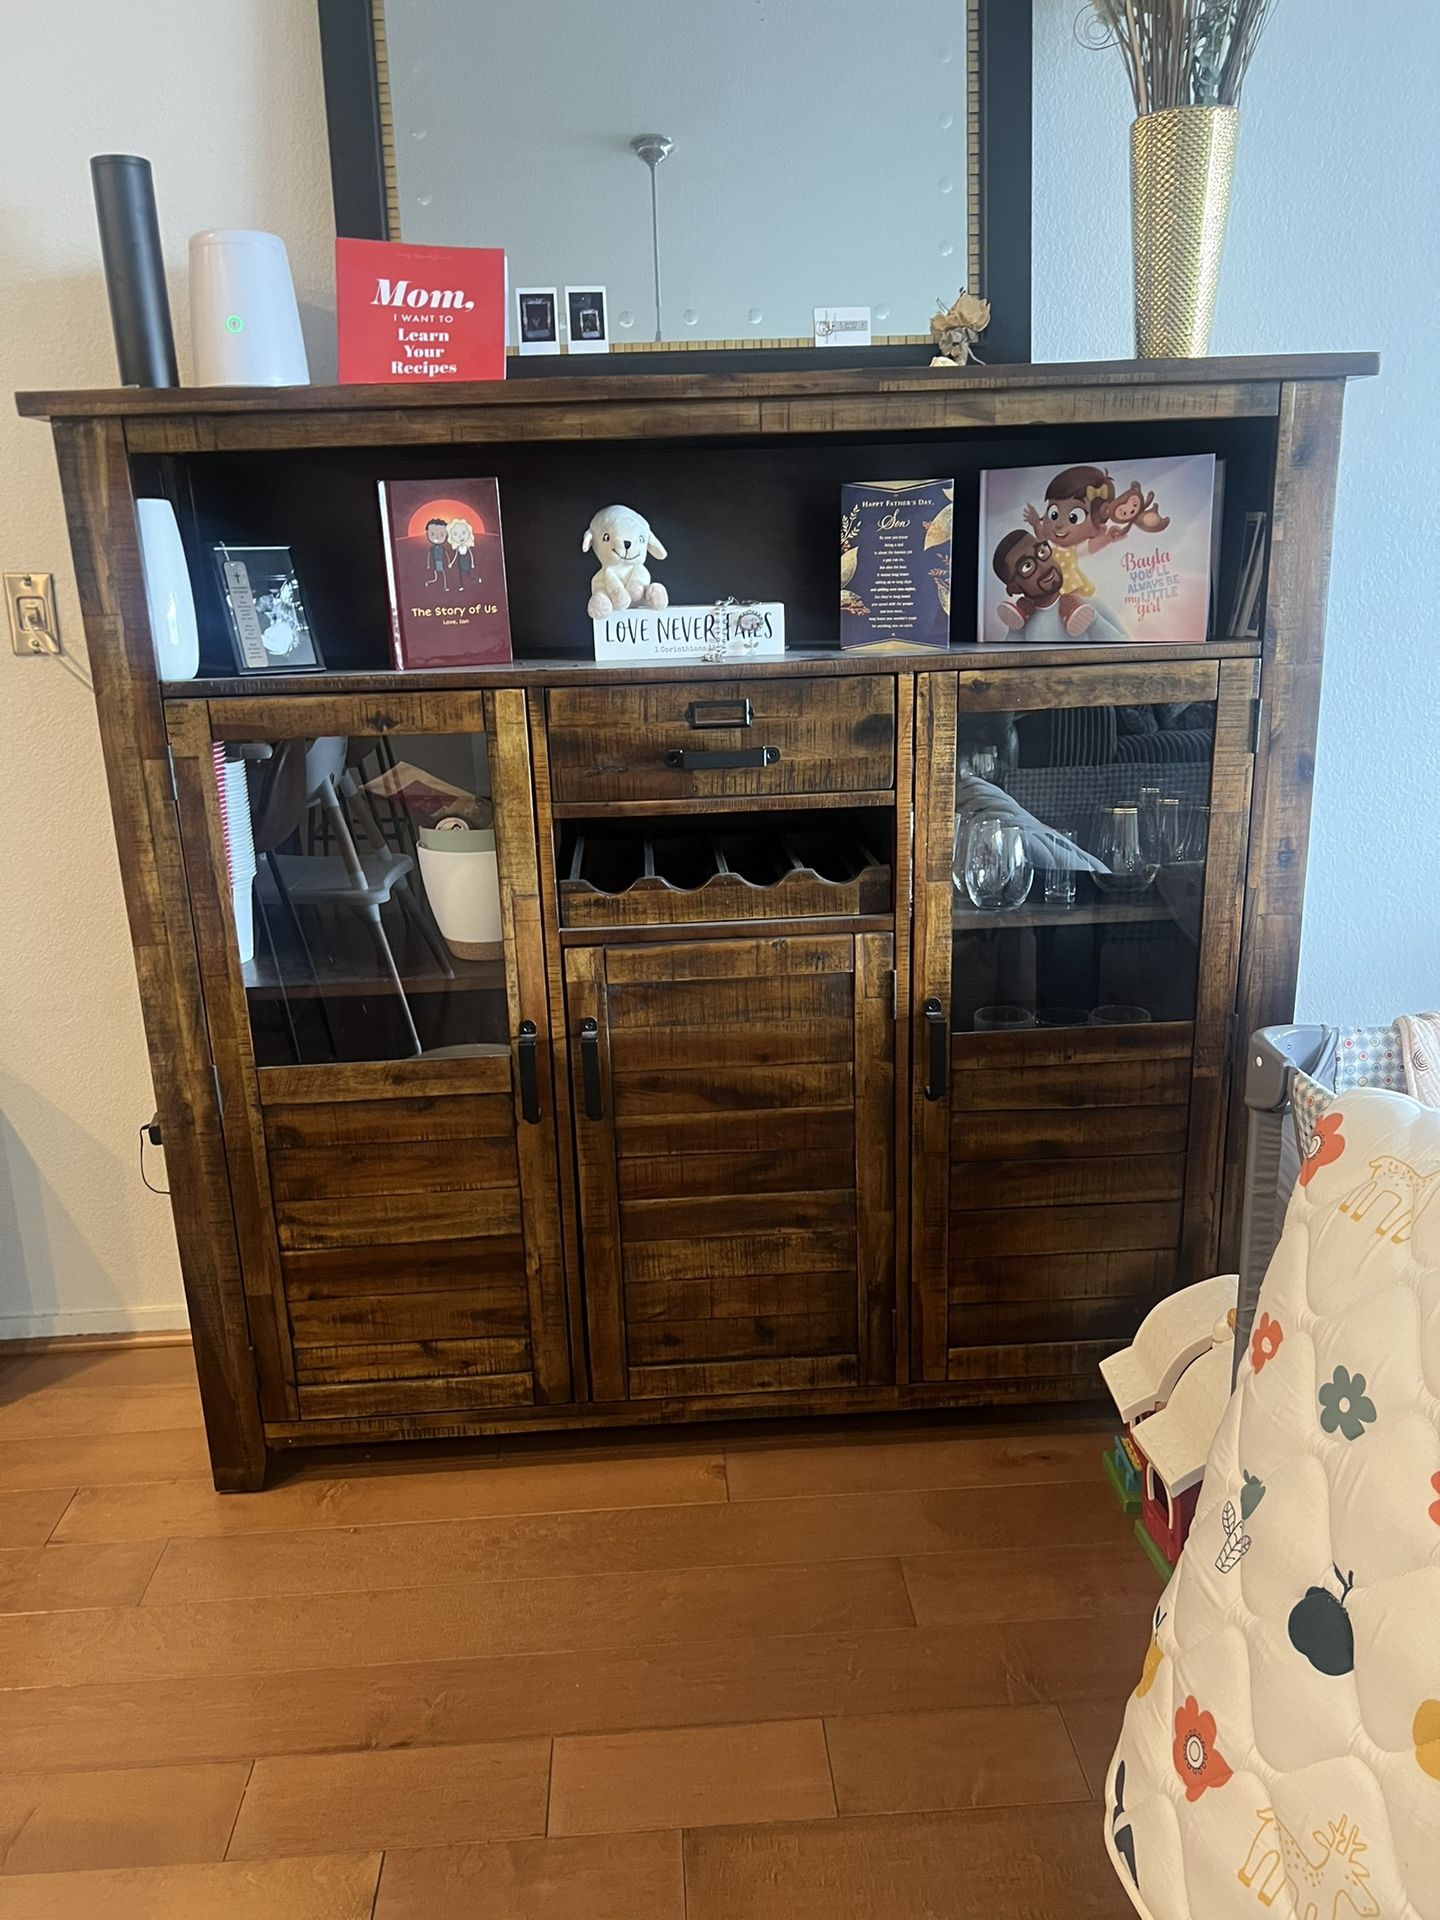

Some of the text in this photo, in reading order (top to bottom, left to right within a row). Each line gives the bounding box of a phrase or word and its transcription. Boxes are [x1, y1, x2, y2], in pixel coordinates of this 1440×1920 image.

[370, 278, 475, 312] Mom,
[393, 313, 453, 323] I WANT TO
[398, 328, 449, 342] Learn
[404, 345, 444, 358] Your
[391, 361, 457, 377] Recipes
[876, 508, 911, 532] Son
[1121, 547, 1170, 572] Bayla
[1128, 574, 1180, 594] ALWAYS BE
[1124, 586, 1178, 607] my LITTLE
[411, 604, 498, 617] The Story of Us
[1136, 596, 1161, 622] girl
[606, 618, 650, 643] LOVE
[657, 613, 718, 643] NEVER
[660, 645, 706, 653] Corinthians
